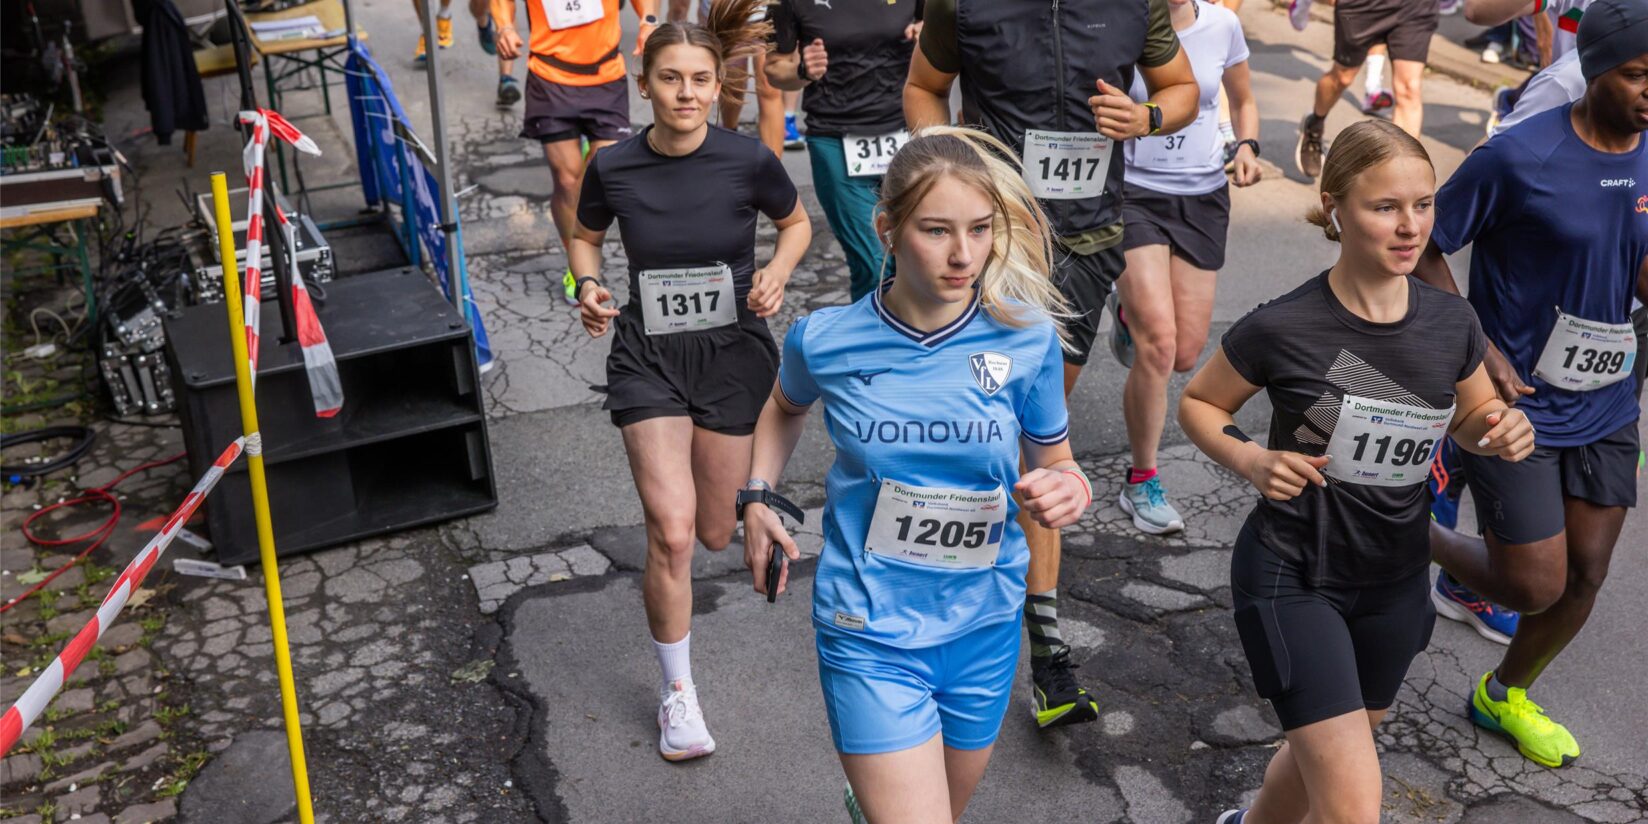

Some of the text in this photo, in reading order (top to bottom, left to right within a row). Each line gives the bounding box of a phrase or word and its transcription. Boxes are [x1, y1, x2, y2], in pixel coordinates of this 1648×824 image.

[856, 136, 899, 159] 313
[1035, 134, 1072, 142] Dortmunder
[1164, 135, 1186, 150] 37
[1038, 156, 1100, 181] 1417
[1600, 179, 1629, 187] CRAFT
[648, 270, 723, 280] Dortmunder Friedenslauf
[656, 290, 721, 317] 1317
[1568, 320, 1609, 333] Dortmunder
[1562, 345, 1626, 374] 1389
[1354, 402, 1404, 416] Dortmunder
[855, 420, 1003, 443] VONOVIA
[1352, 432, 1434, 467] 1196
[893, 485, 947, 500] Dortmunder
[895, 515, 988, 549] 1205
